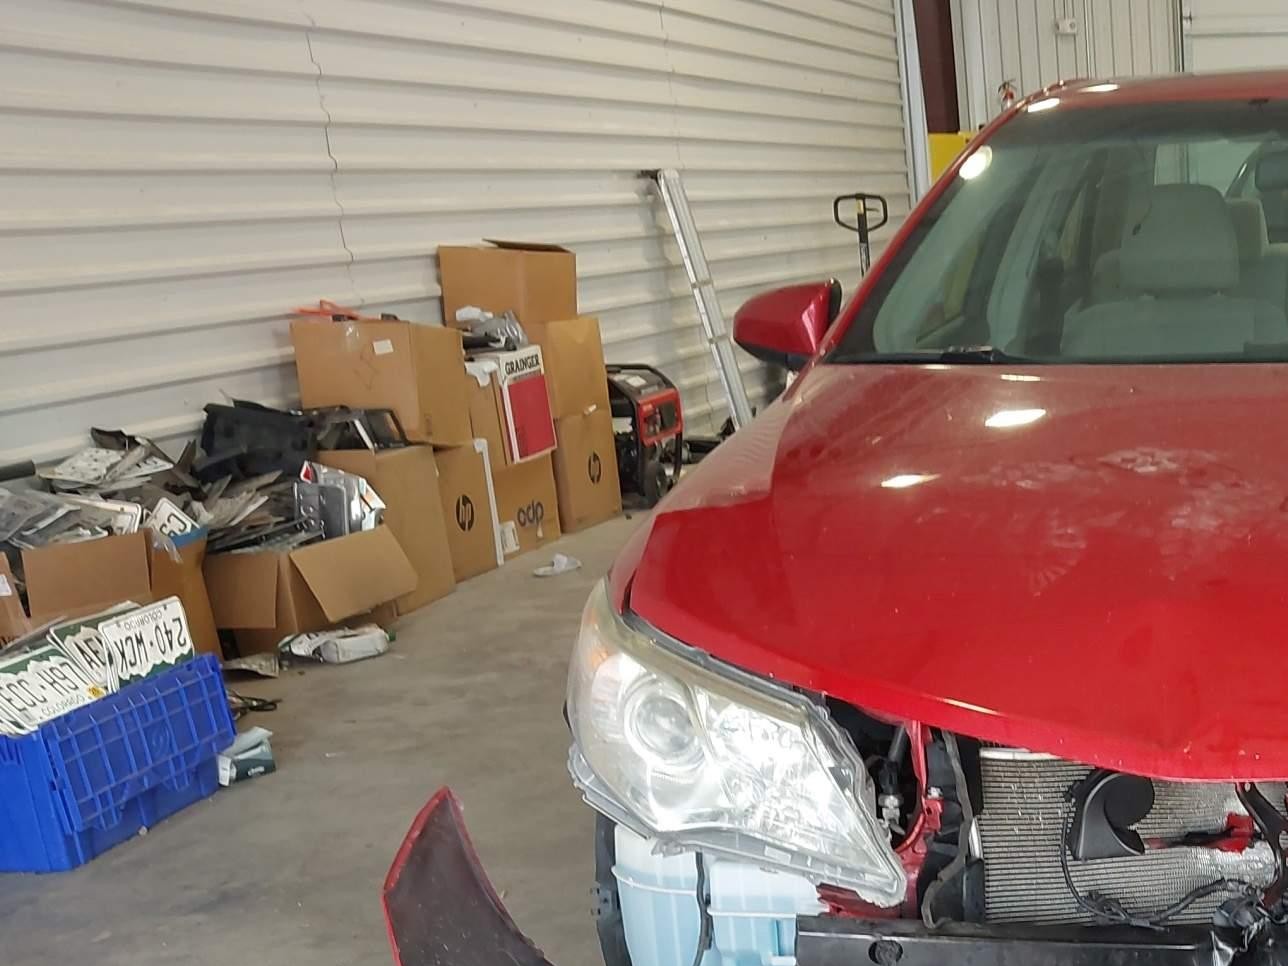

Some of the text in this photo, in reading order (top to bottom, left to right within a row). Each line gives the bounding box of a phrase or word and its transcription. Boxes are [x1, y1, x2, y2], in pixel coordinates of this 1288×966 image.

[505, 354, 540, 375] GRAINGER
[456, 494, 474, 532] hp
[517, 500, 544, 527] odp
